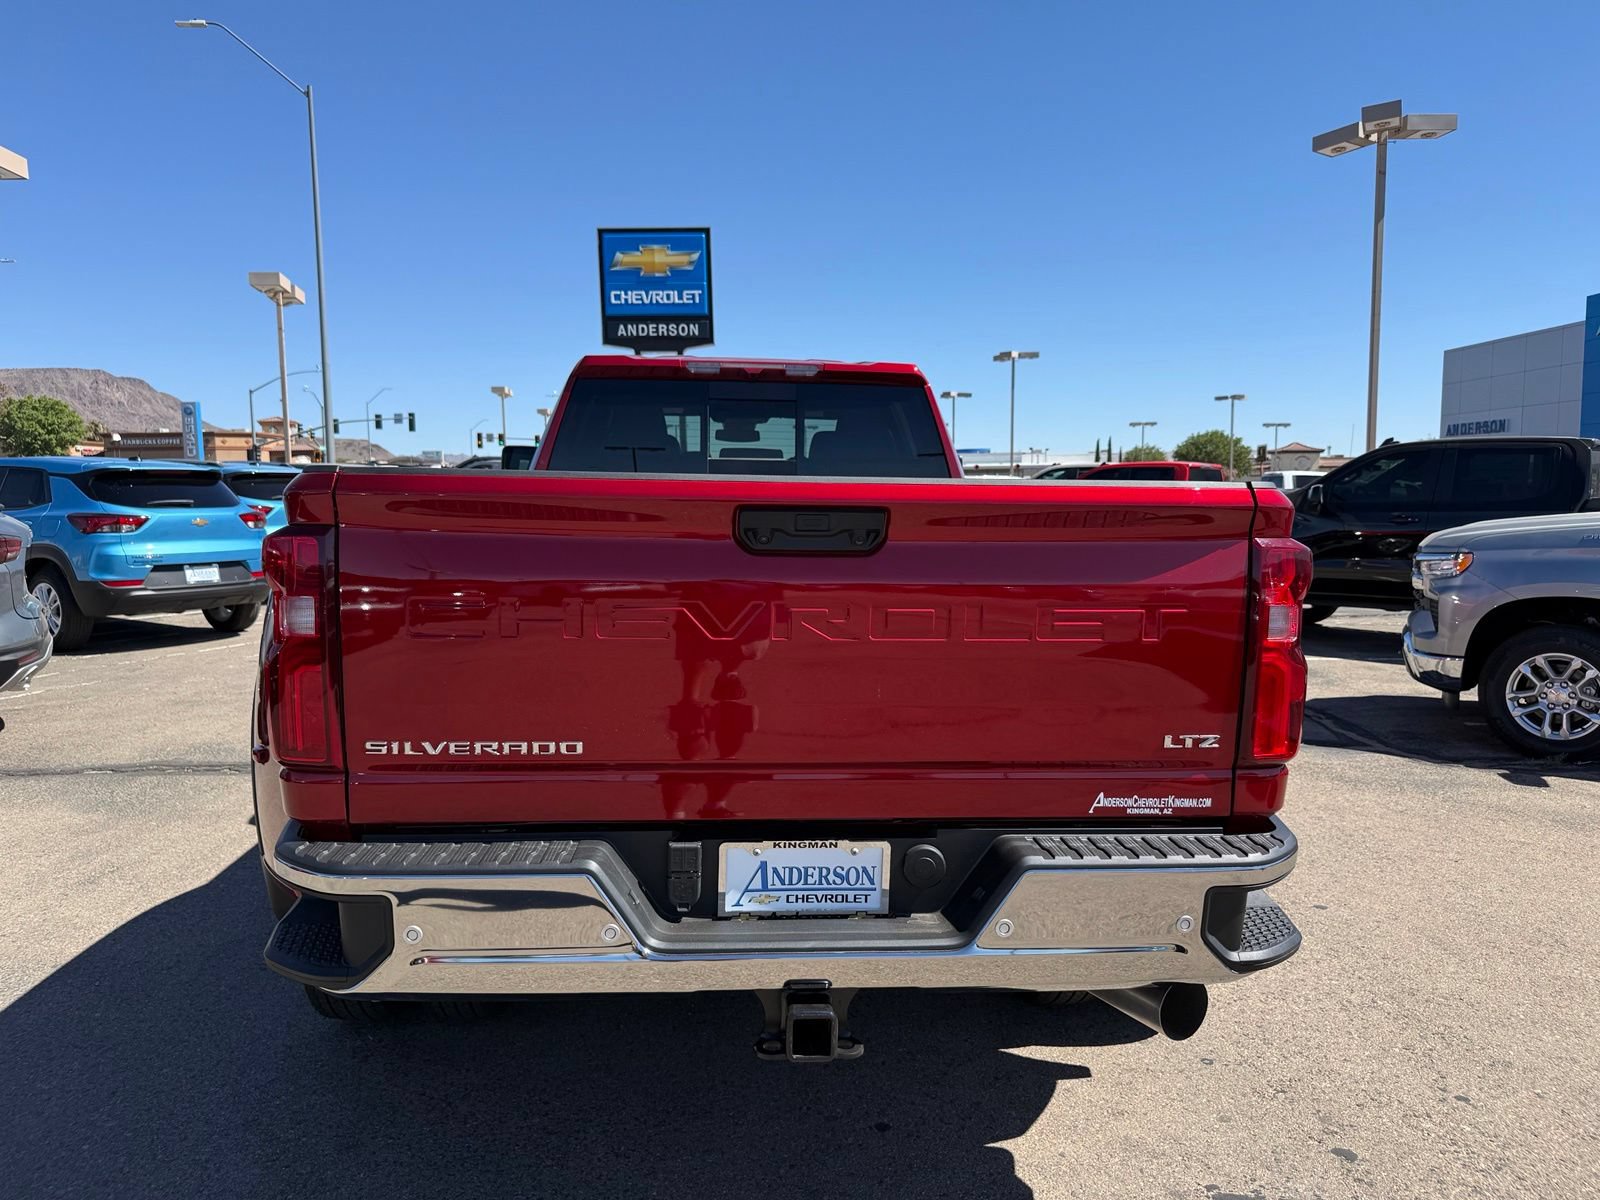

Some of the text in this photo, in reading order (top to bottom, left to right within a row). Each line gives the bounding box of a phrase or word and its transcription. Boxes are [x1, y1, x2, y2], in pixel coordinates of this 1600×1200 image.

[610, 290, 702, 304] CHEVROLET
[617, 323, 699, 336] ANDERSON
[1446, 418, 1506, 437] ANDERSON
[184, 417, 197, 458] CHASE
[406, 597, 1189, 642] CHEVROLET
[364, 741, 584, 756] SILVERADO
[1163, 734, 1221, 749] LTZ
[1126, 807, 1162, 815] KINGMAN,
[772, 841, 839, 849] KINGMAN
[731, 860, 878, 907] ANDERSON
[785, 894, 872, 904] CHEVROLET
